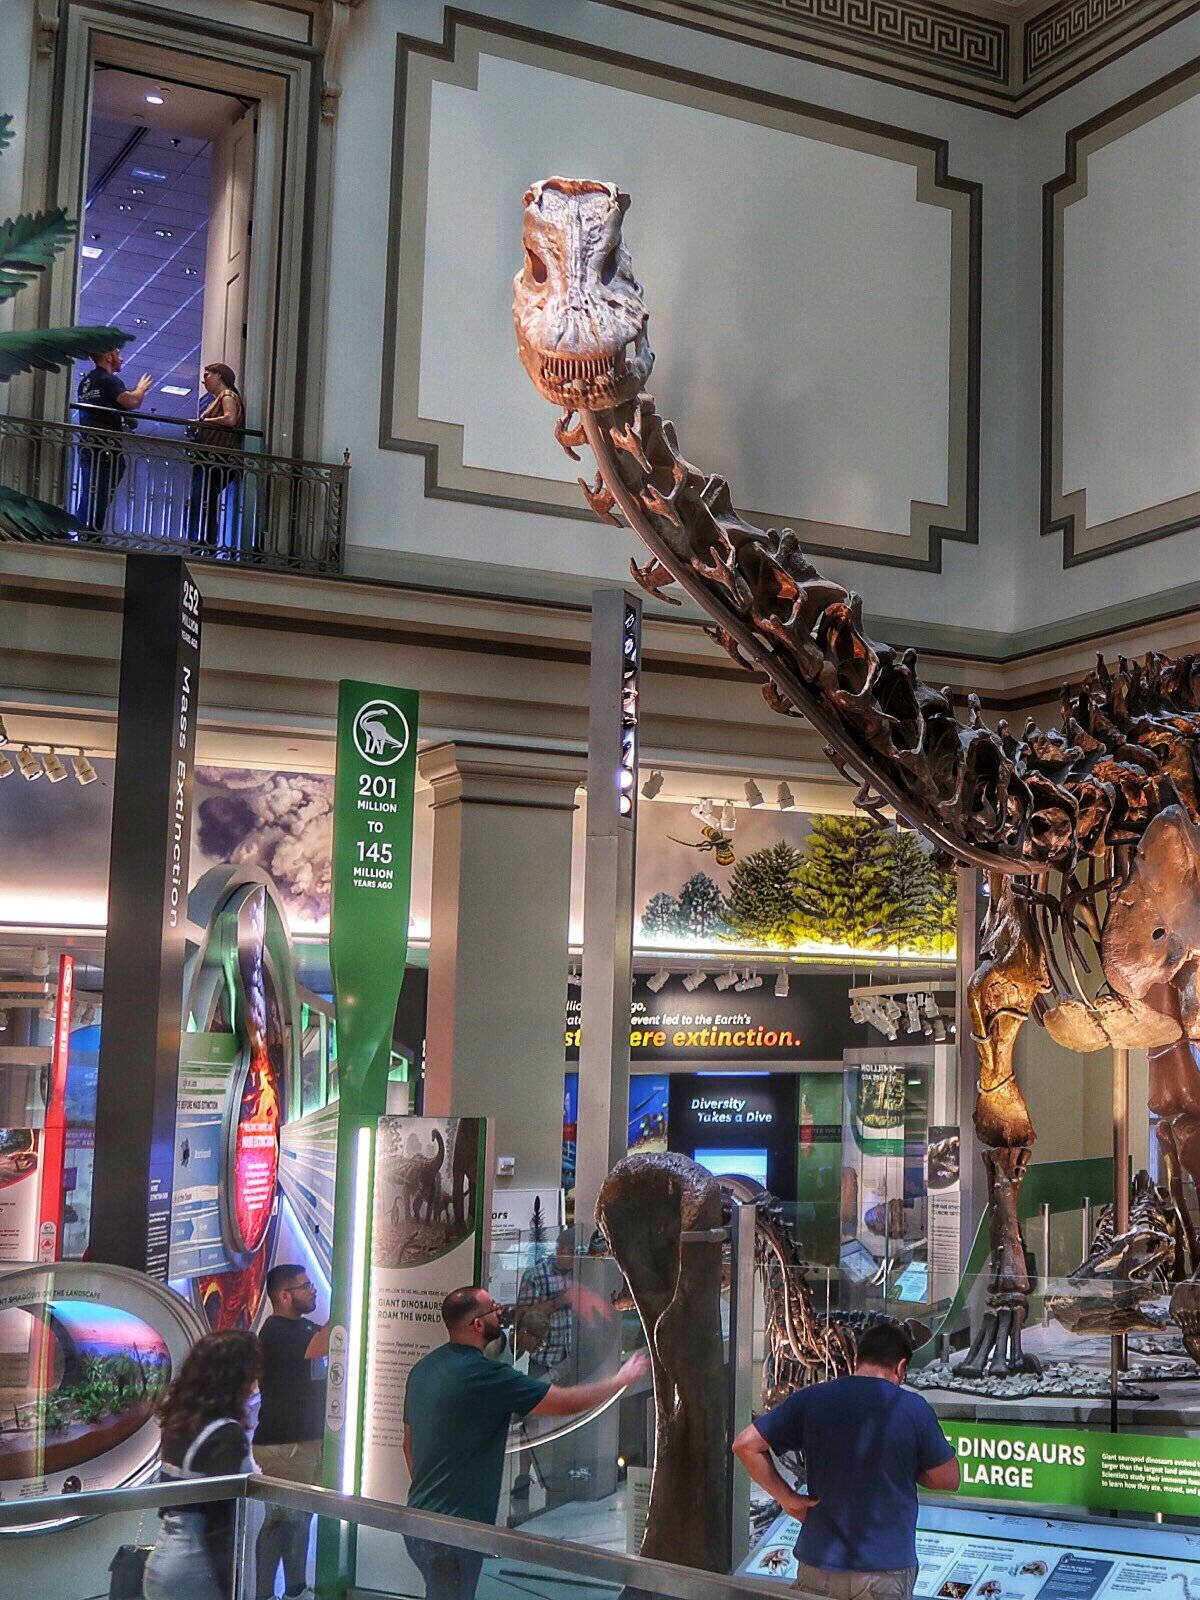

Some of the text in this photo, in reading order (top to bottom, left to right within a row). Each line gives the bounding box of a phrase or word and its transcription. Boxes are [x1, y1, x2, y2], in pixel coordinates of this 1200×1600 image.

[183, 580, 199, 616] 252
[178, 666, 191, 749] Mass
[358, 774, 397, 799] 201
[357, 800, 397, 813] MILLION
[367, 821, 384, 833] TO
[169, 759, 186, 928] Extinction
[356, 841, 393, 864] 145
[353, 867, 394, 879] MILLION
[353, 879, 393, 890] YEARS AGO
[630, 1002, 646, 1013] go,
[630, 1014, 751, 1025] event led to the Earth's
[672, 1026, 802, 1047] extinction.
[691, 1098, 746, 1112] Diversity
[698, 1112, 772, 1123] Takes a Dive
[378, 1298, 443, 1311] GIANT DINOSAURS
[377, 1310, 441, 1323] ROAM THE WORLD
[957, 1436, 1086, 1467] DINOSAURS
[1101, 1453, 1117, 1461] Giant
[1118, 1454, 1145, 1463] sauropod
[1145, 1456, 1173, 1465] dinosaurs
[1174, 1459, 1197, 1467] evolved
[963, 1463, 1034, 1488] LARGE
[1101, 1462, 1119, 1471] larger
[1119, 1463, 1132, 1471] than
[1133, 1464, 1143, 1472] the
[1144, 1465, 1163, 1475] largest
[1164, 1466, 1178, 1475] land
[1178, 1467, 1200, 1477] animals
[1101, 1471, 1129, 1480] Scientists
[1129, 1473, 1145, 1482] study
[1146, 1474, 1160, 1482] their
[1160, 1476, 1188, 1485] immense
[1101, 1480, 1108, 1488] to
[1108, 1481, 1124, 1489] learn
[1124, 1482, 1137, 1490] how
[1137, 1483, 1151, 1492] they
[1185, 1487, 1197, 1495] and
